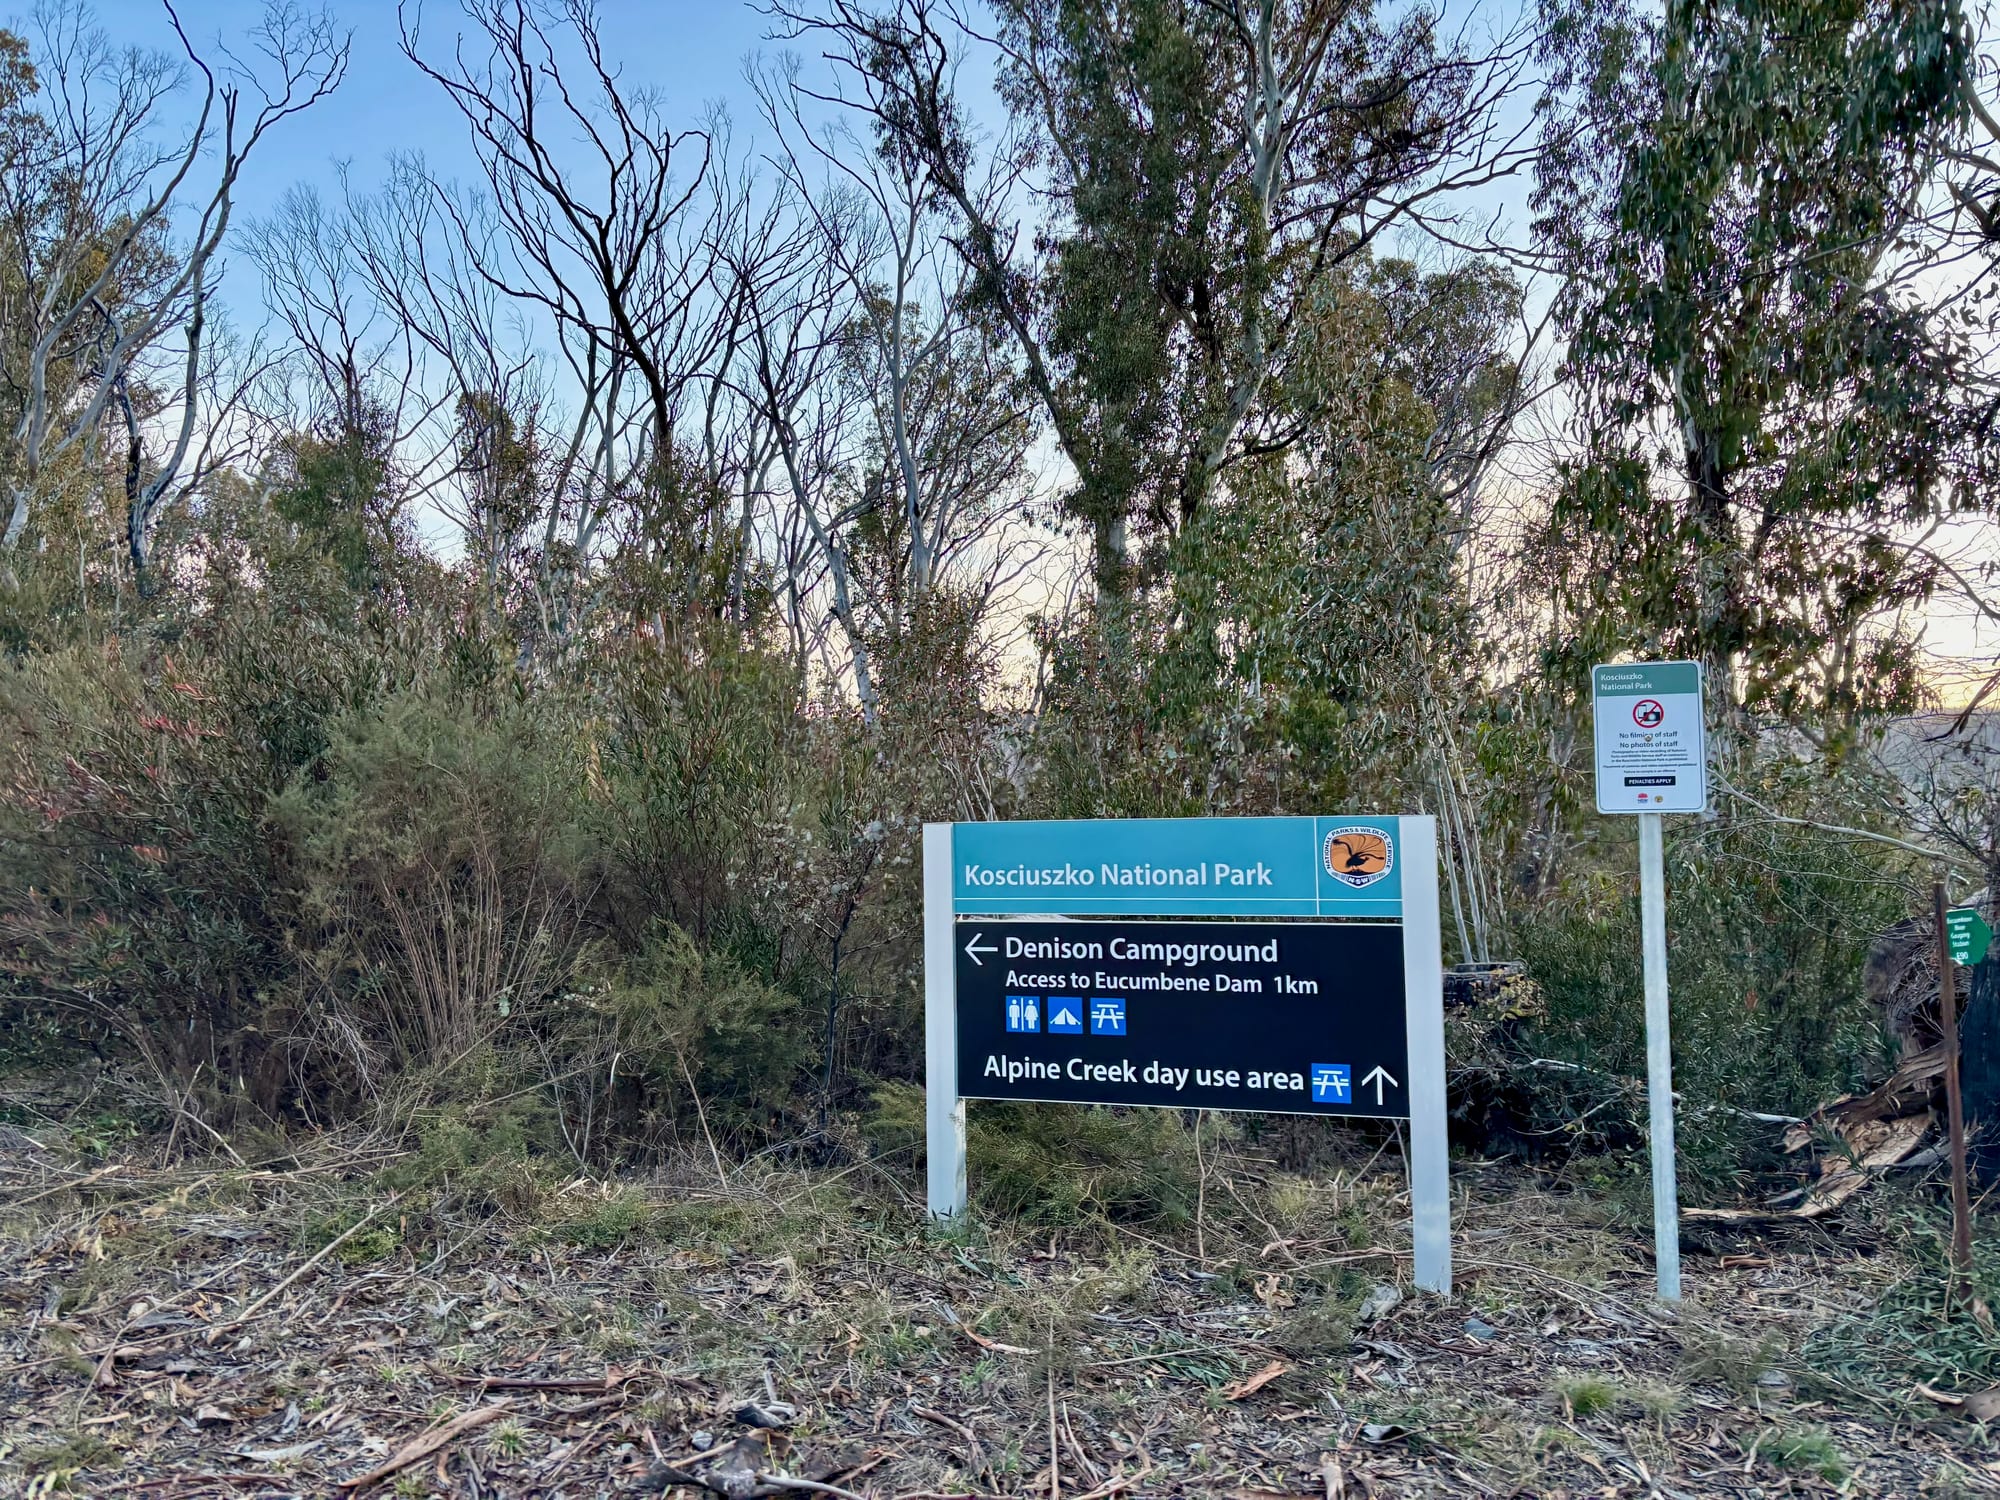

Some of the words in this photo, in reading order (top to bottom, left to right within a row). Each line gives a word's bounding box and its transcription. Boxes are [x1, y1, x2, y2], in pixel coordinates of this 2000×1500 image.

[1600, 672, 1643, 681] Kosciuszko
[1601, 682, 1634, 690] National
[1630, 741, 1654, 749] photos
[1331, 827, 1354, 837] PARKS
[964, 863, 1095, 886] Kosciuszko
[1101, 862, 1207, 886] National
[1214, 862, 1273, 886] Park
[1005, 936, 1103, 960] Denison
[1109, 937, 1278, 967] Campground
[1005, 970, 1066, 989] Access
[1069, 973, 1090, 990] to
[1095, 971, 1210, 992] Eucumbene
[1215, 974, 1262, 993] Dam
[1273, 974, 1318, 994] 1km
[983, 1054, 1061, 1083] Alpine
[1066, 1057, 1137, 1083] Creek
[1142, 1060, 1189, 1091] day
[1196, 1068, 1240, 1088] use
[1246, 1070, 1304, 1090] area
